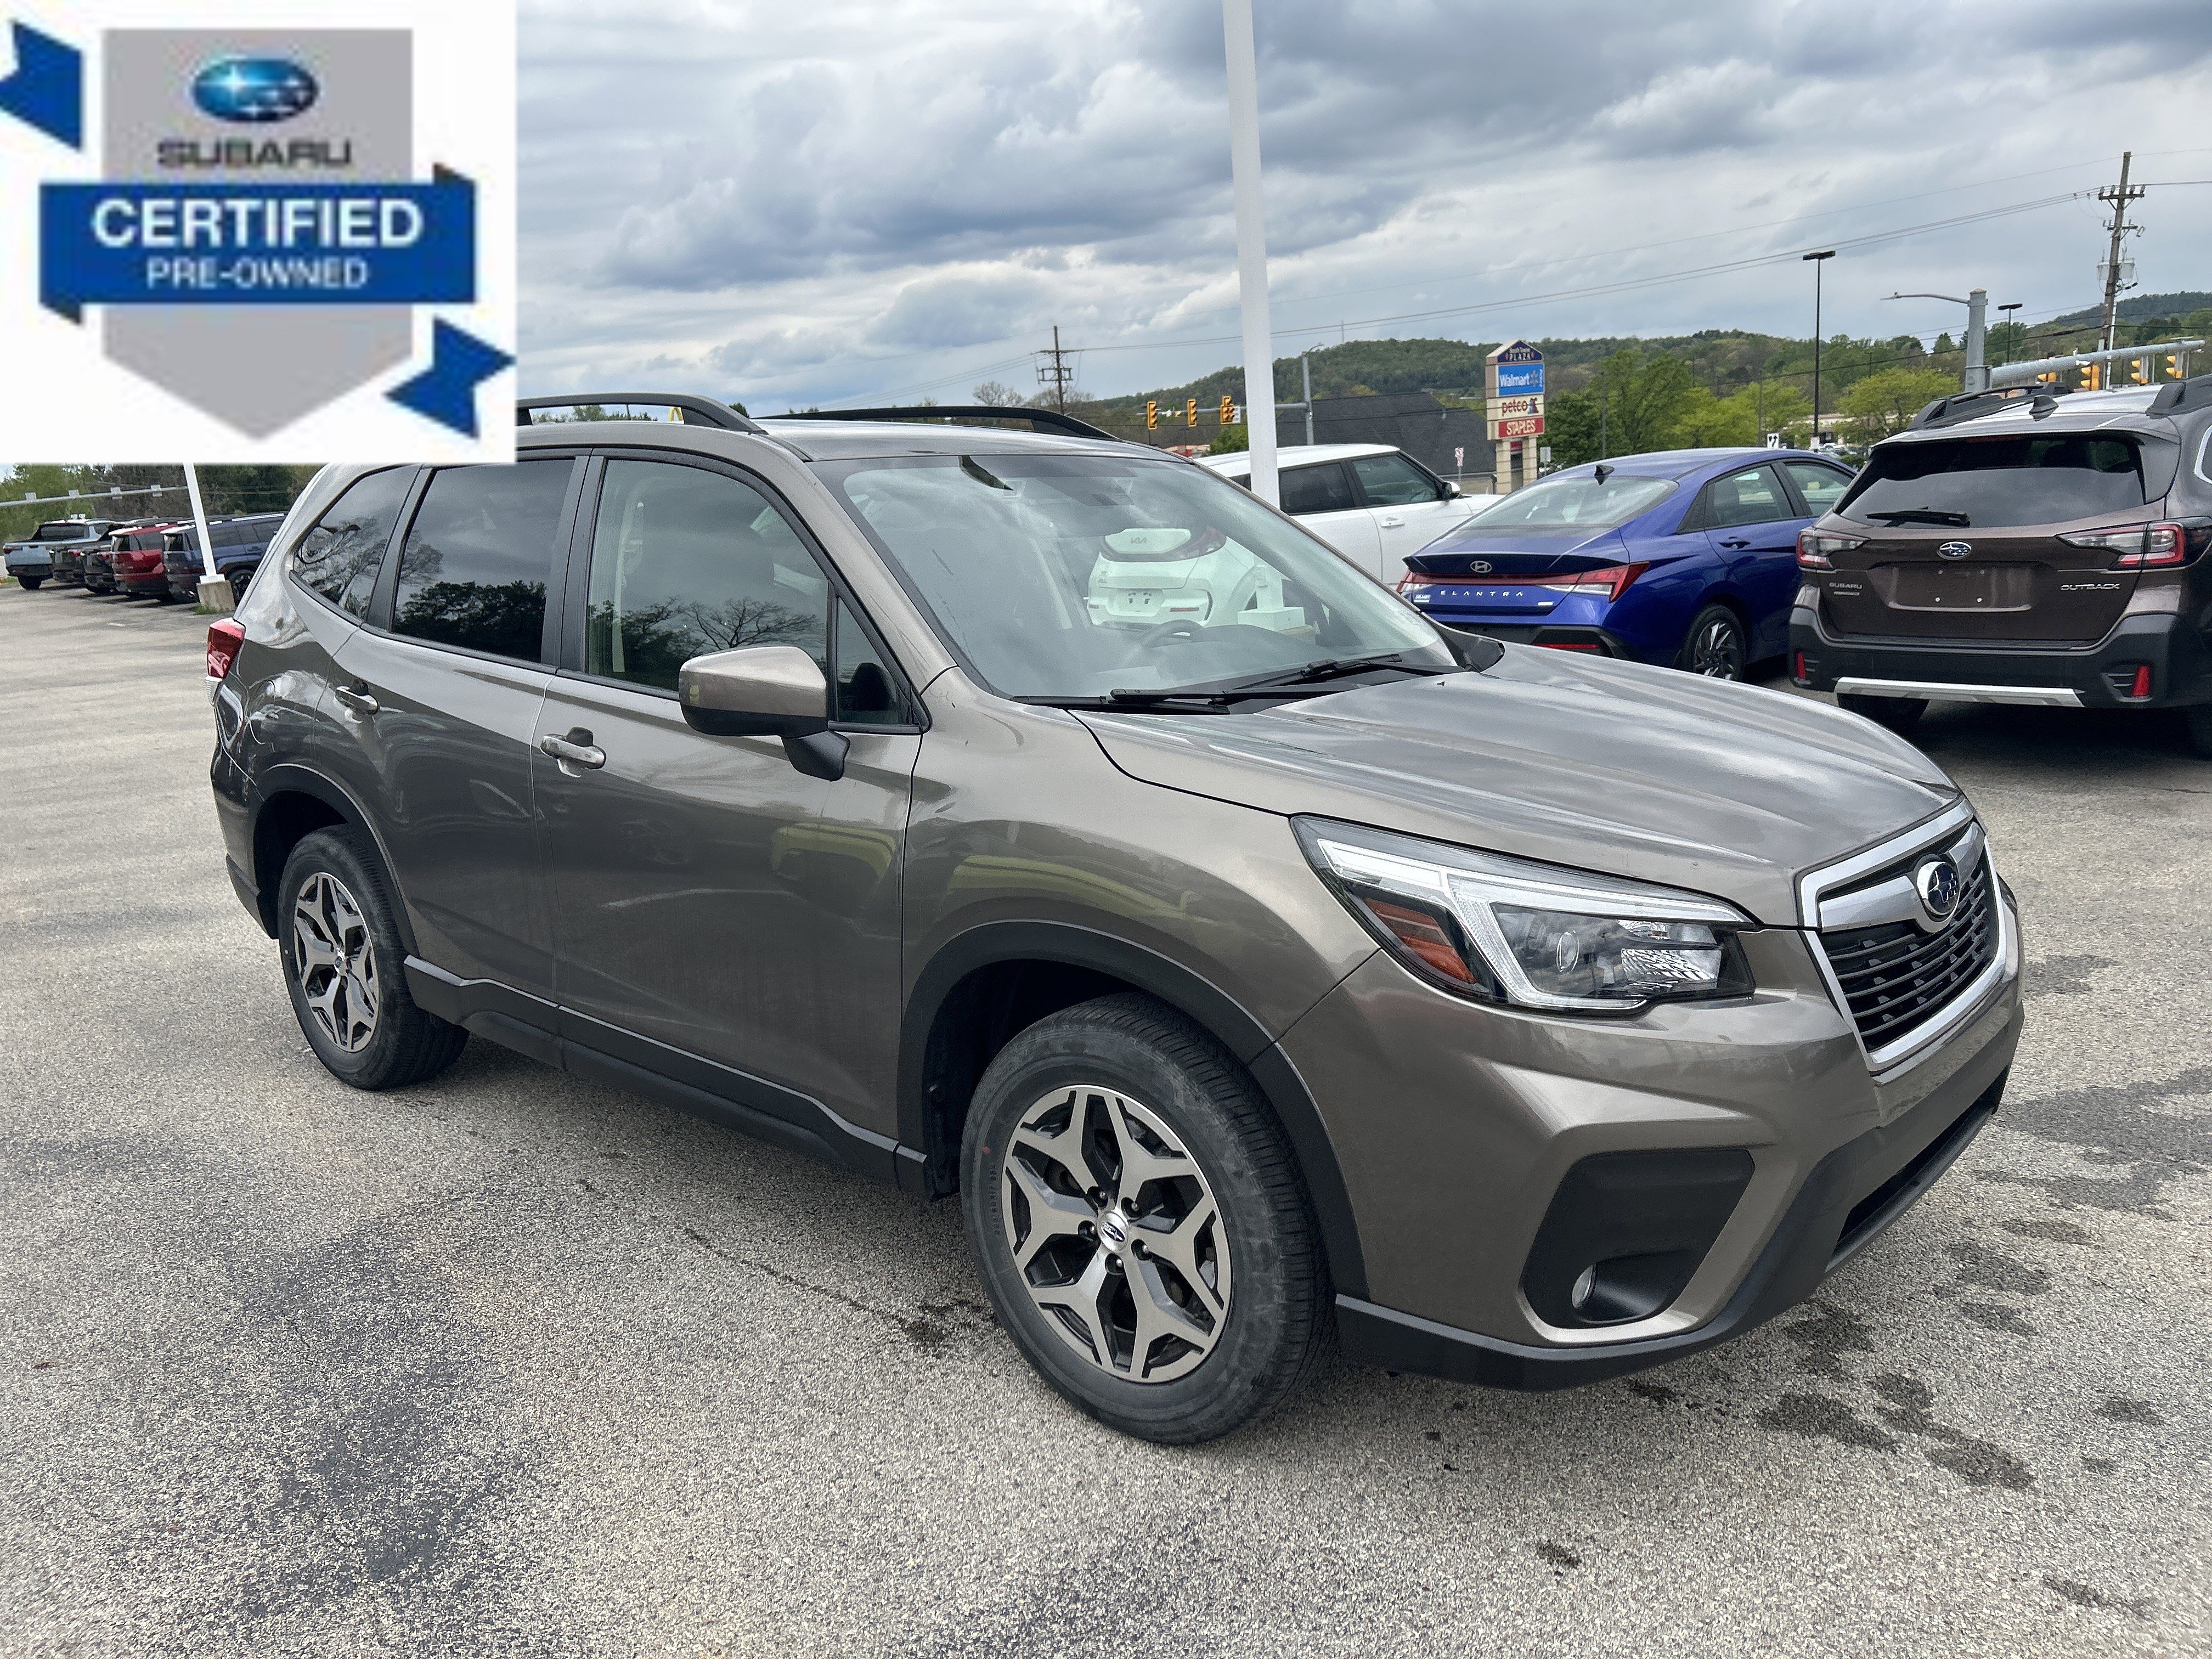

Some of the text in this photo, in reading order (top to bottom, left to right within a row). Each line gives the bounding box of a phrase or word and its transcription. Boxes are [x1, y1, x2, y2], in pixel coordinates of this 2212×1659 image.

[1509, 352, 1531, 362] PLAZA
[1499, 373, 1530, 387] Walmart
[1502, 399, 1528, 417] petco
[1506, 419, 1536, 436] STAPLES
